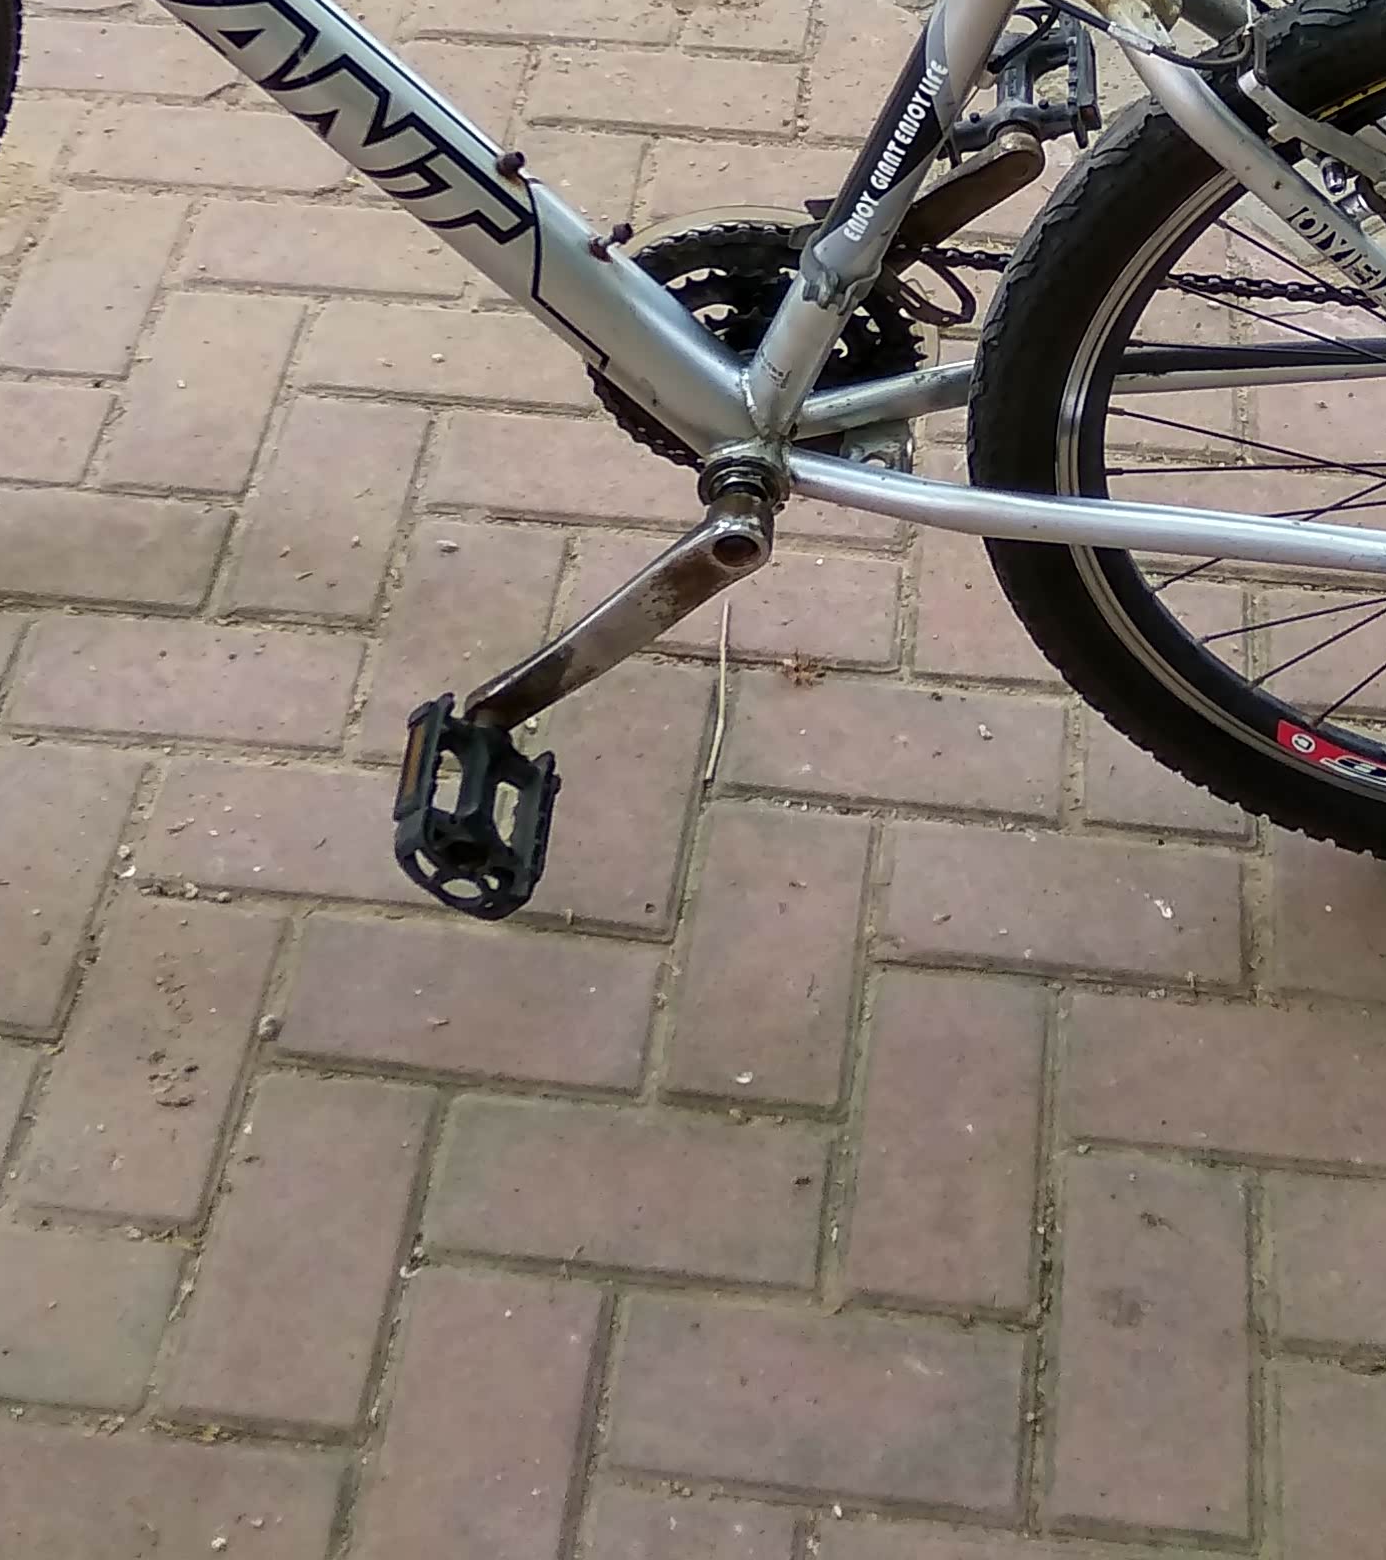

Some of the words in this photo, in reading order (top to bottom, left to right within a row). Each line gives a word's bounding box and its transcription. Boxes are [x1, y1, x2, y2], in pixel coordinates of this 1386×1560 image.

[842, 189, 880, 242] ENJOY
[869, 140, 907, 190] GIANT
[893, 89, 933, 146] ENJOY
[917, 59, 950, 98] LIFE
